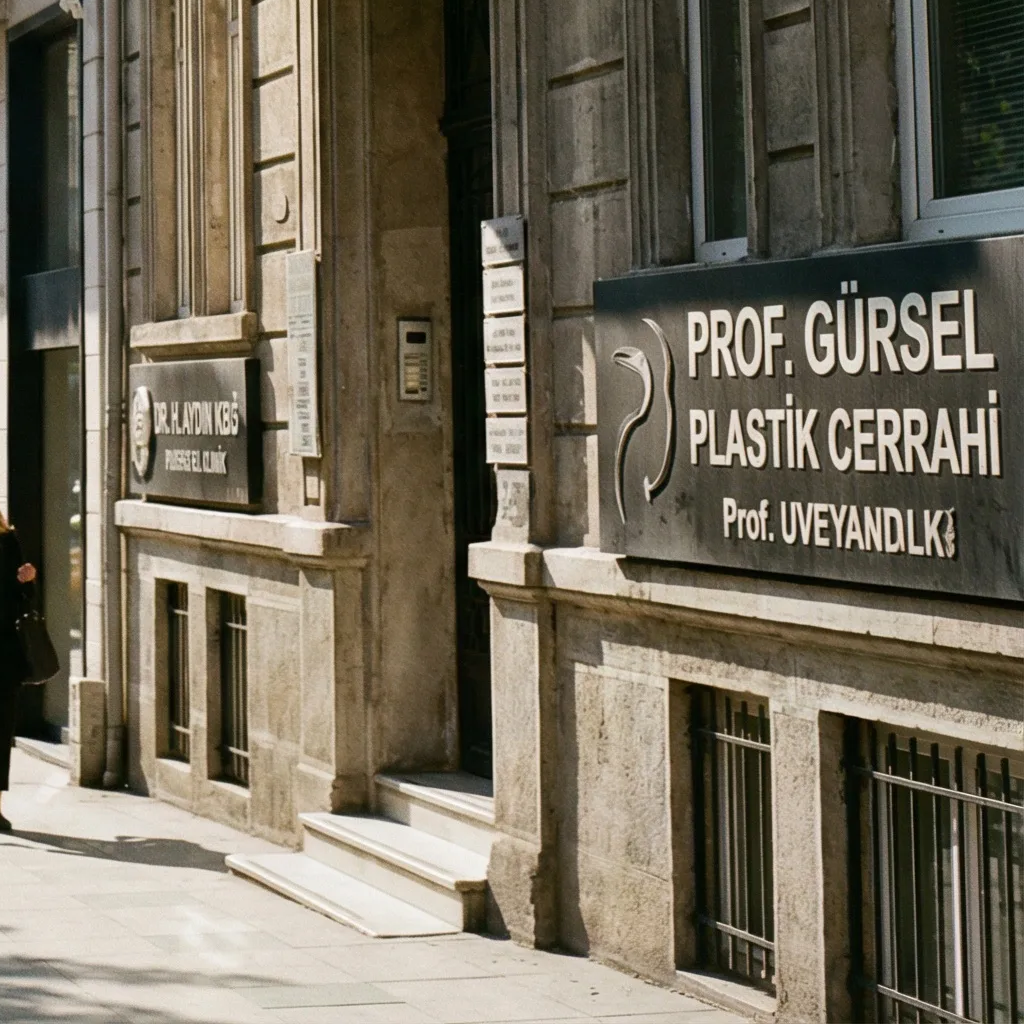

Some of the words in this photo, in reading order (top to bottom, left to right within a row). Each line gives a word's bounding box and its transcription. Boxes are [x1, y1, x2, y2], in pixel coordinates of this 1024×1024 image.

[687, 304, 793, 378] PROF.
[804, 280, 995, 376] GÜRSEL
[689, 393, 821, 471] PLASTİK
[828, 389, 1001, 477] CERRAHİ
[723, 497, 774, 542] Prof.
